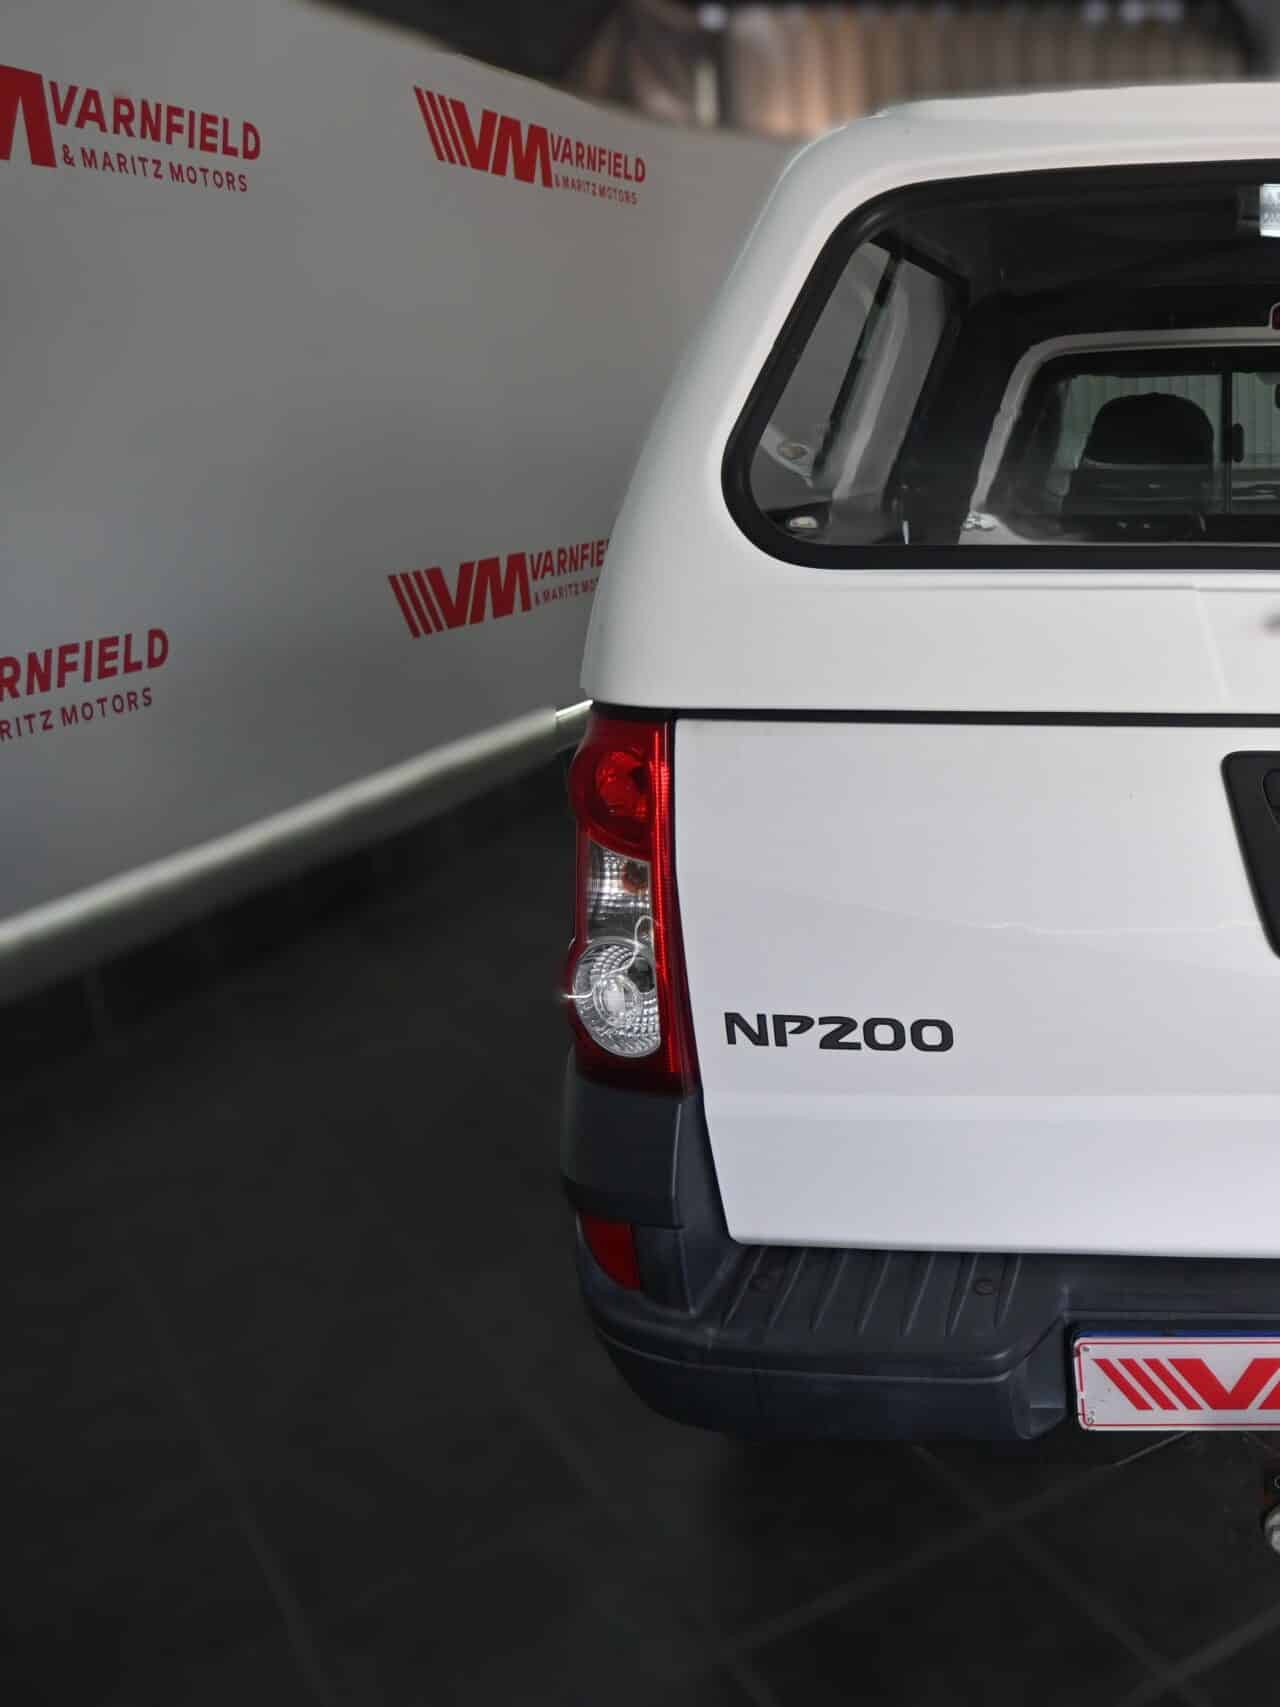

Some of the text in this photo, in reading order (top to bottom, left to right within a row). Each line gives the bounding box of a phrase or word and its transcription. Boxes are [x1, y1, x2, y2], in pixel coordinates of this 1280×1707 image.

[49, 80, 262, 161] VARNFIELD
[62, 144, 248, 192] & MARITZ MOTORS
[550, 132, 646, 183] VARNFIELD
[60, 687, 153, 727] MOTORS
[724, 1011, 954, 1052] NP200
